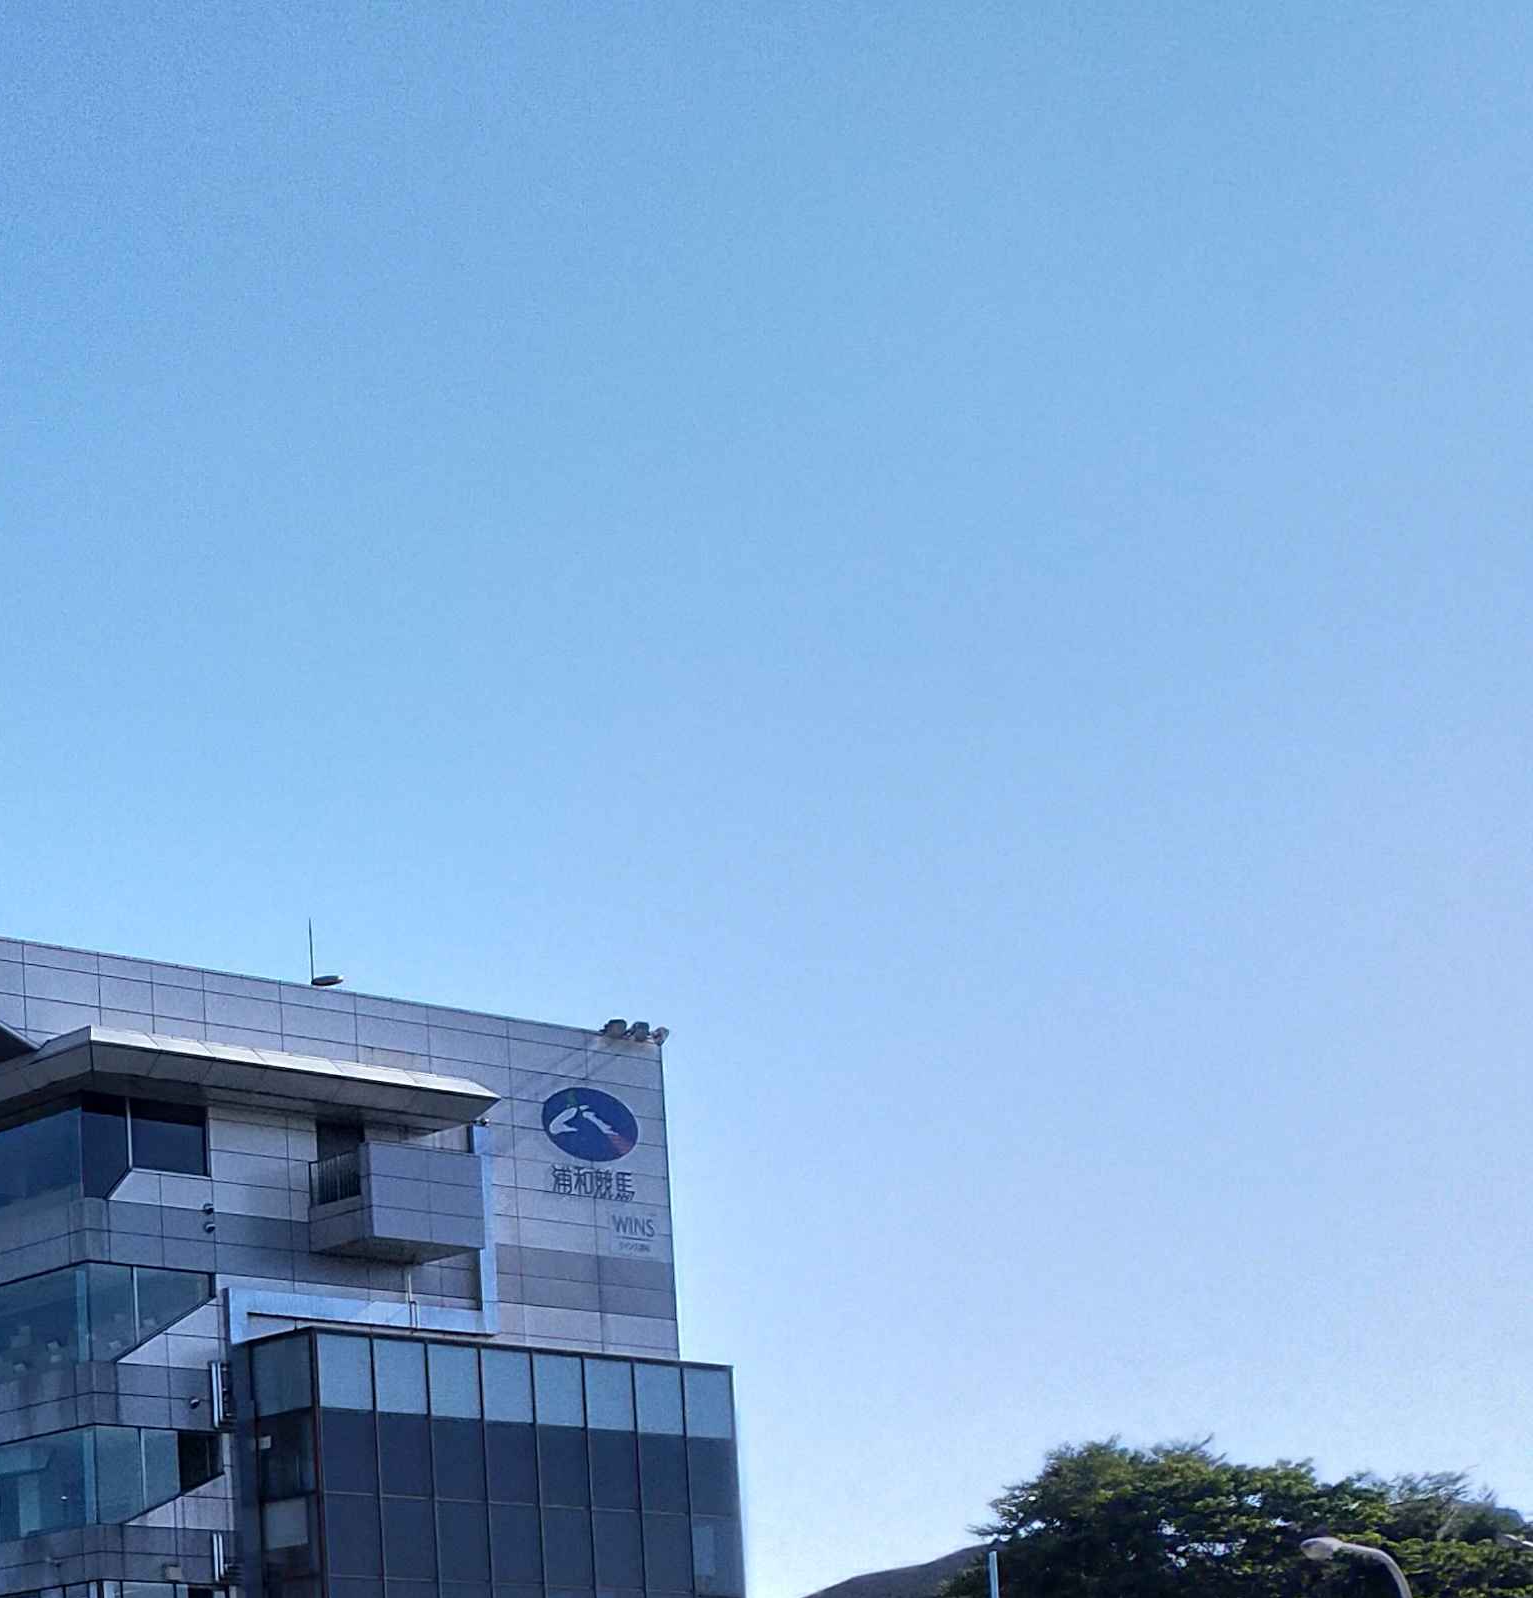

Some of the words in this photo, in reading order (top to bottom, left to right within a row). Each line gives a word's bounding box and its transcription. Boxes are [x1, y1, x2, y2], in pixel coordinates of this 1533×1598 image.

[552, 1164, 635, 1201] 浦和競馬
[612, 1215, 655, 1238] WINS
